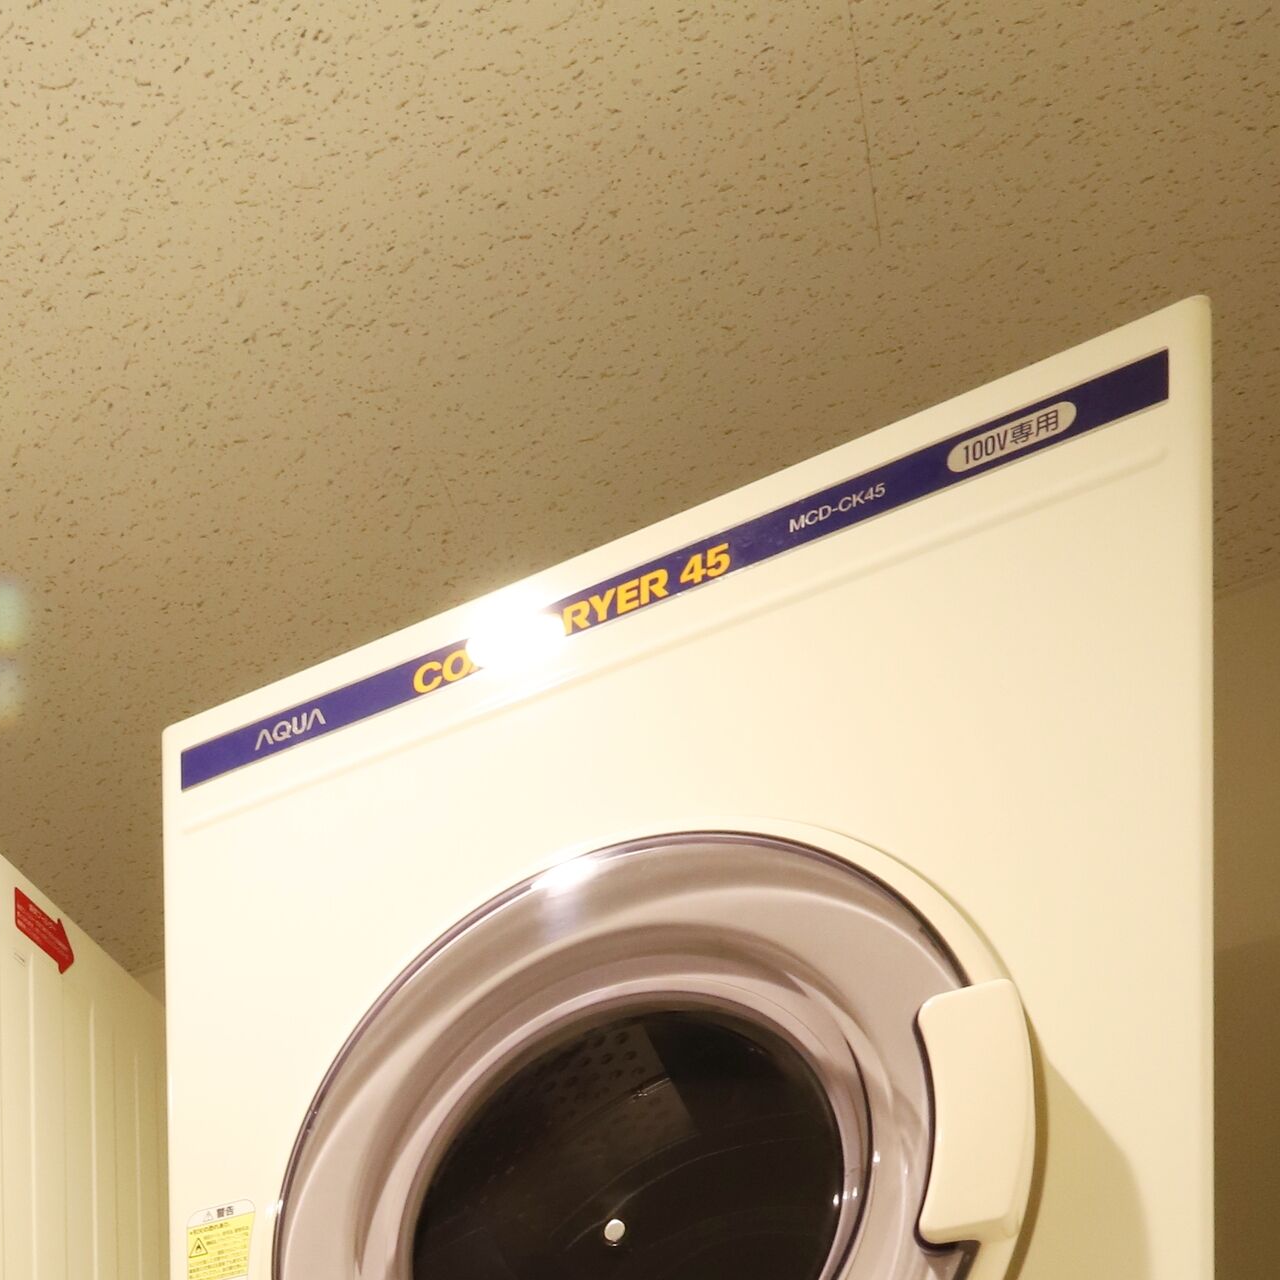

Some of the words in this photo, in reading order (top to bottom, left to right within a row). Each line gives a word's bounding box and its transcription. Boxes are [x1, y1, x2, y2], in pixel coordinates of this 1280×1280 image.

[963, 408, 1059, 465] 100V専用
[788, 482, 887, 534] MCD-CK45
[550, 569, 668, 636] RYER
[679, 543, 731, 584] 45
[255, 707, 327, 751] AQUA
